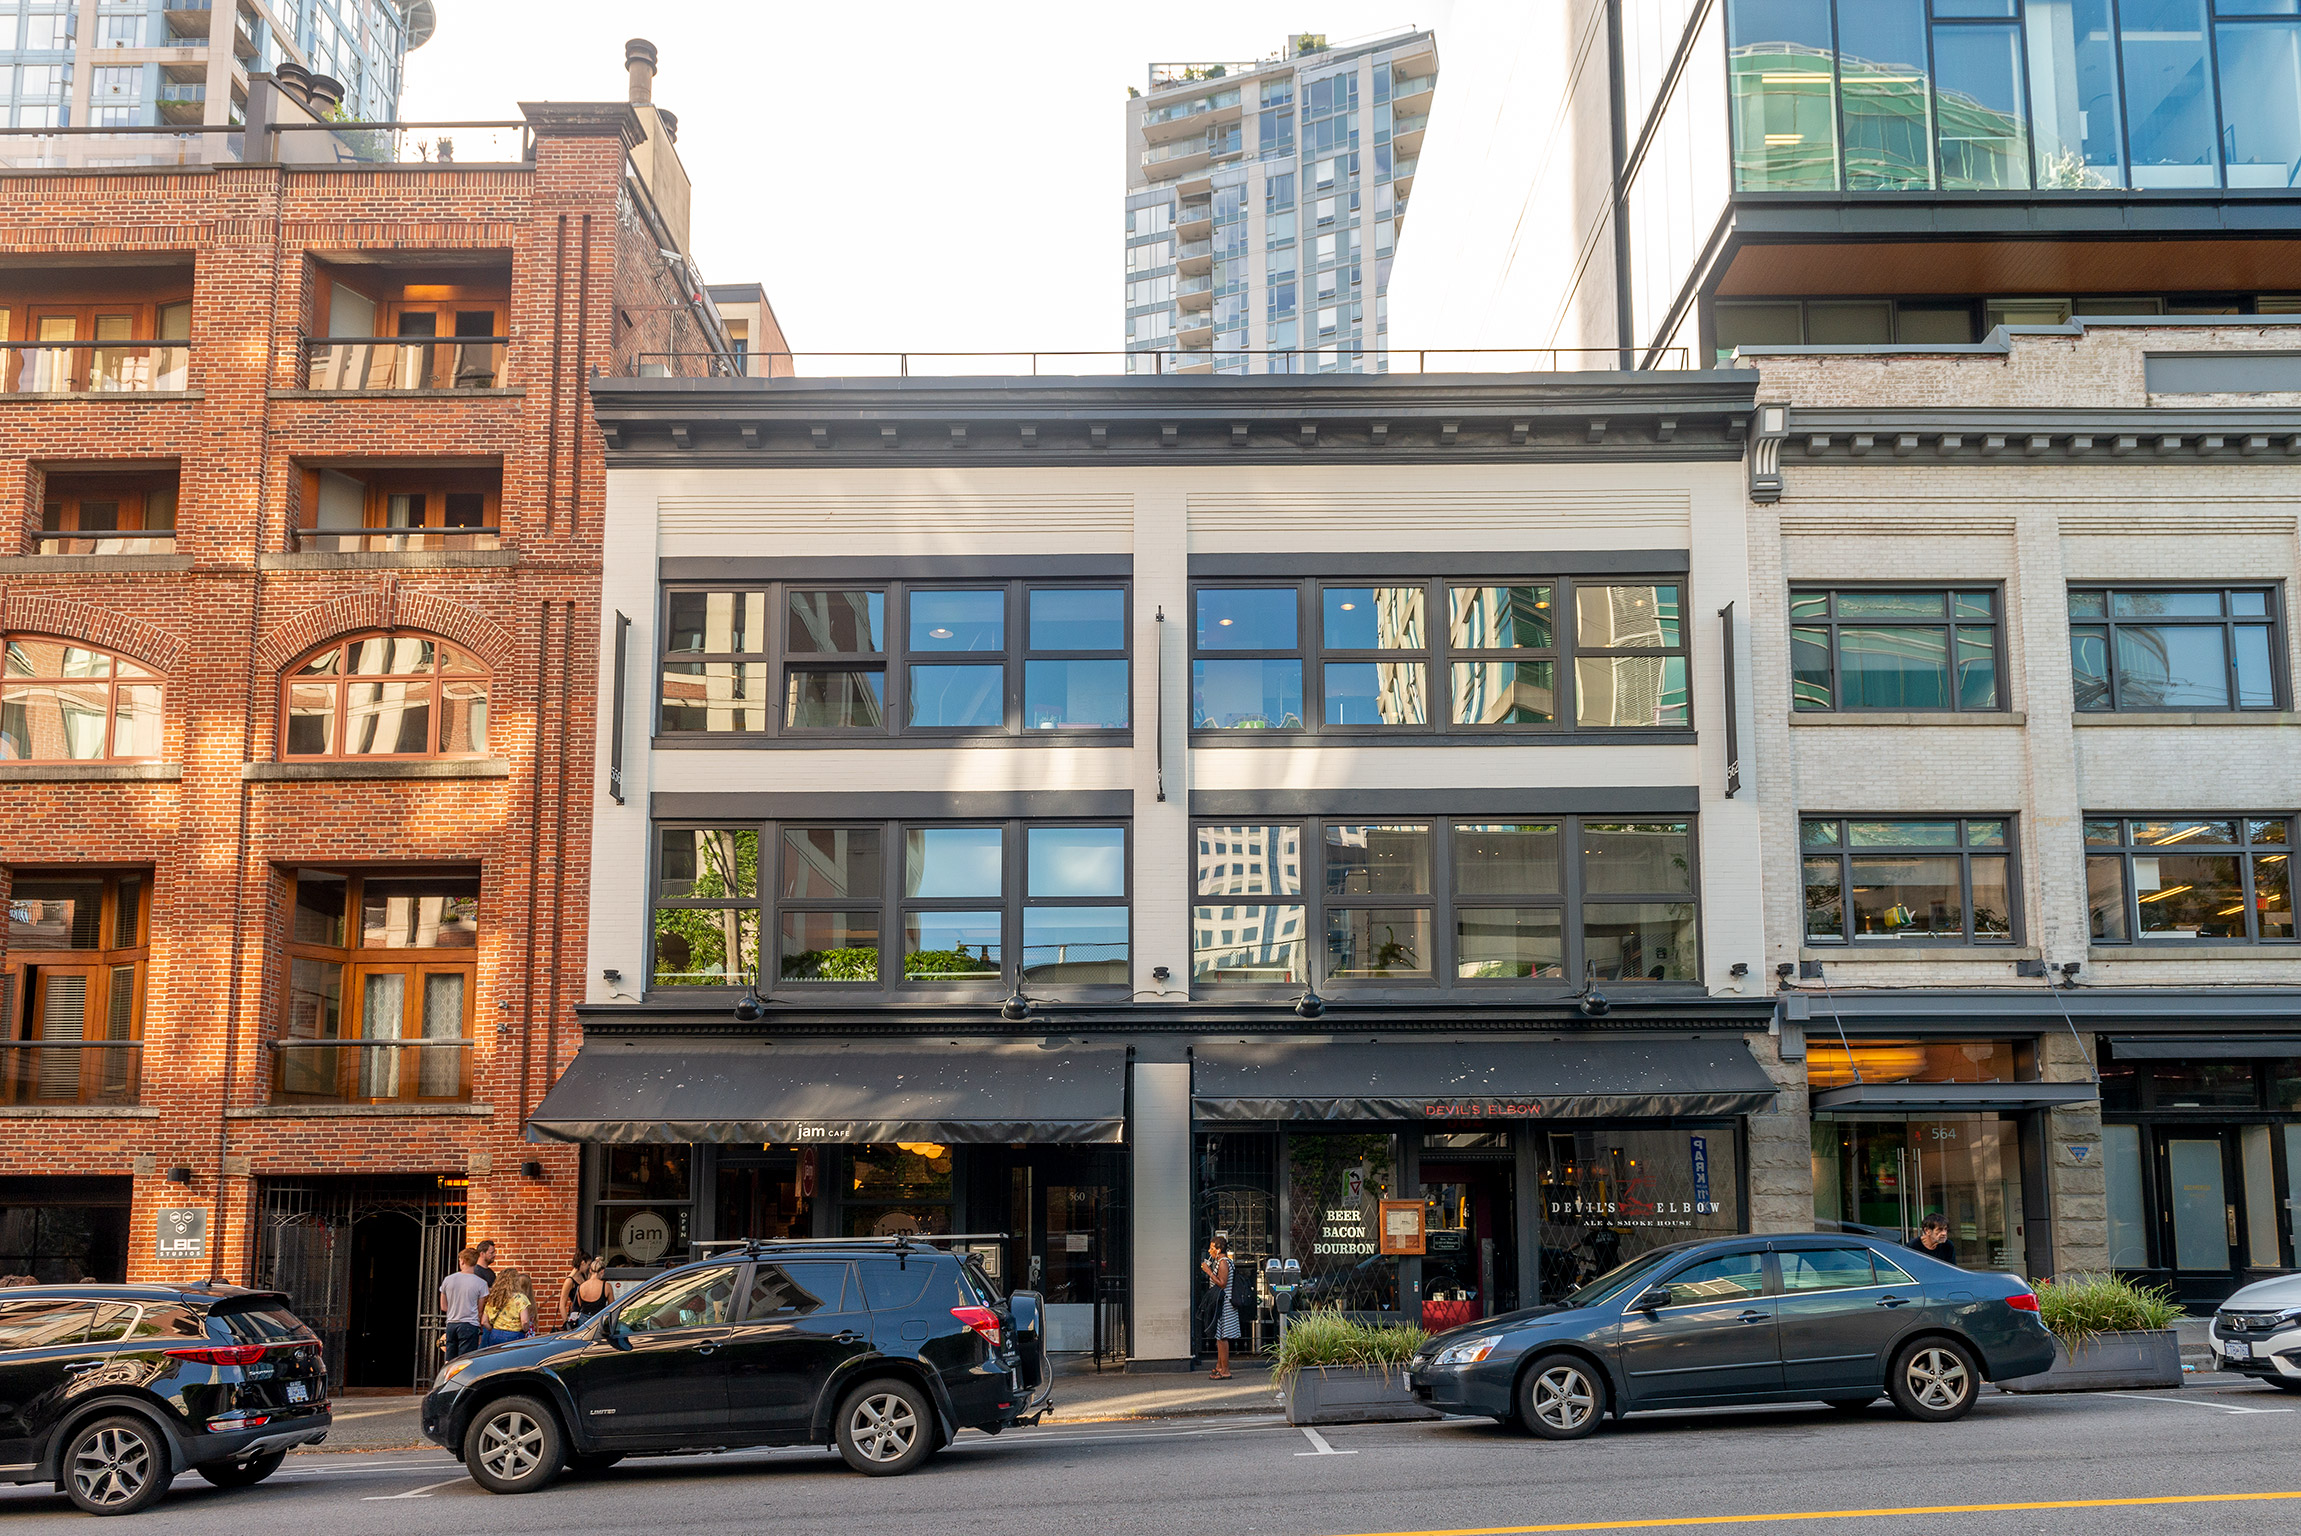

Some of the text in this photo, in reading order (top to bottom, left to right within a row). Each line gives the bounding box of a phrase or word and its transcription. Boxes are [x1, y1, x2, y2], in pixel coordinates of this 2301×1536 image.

[1426, 1105, 1541, 1115] DEVIL'S ELBOW
[797, 1124, 825, 1140] jam
[1931, 1127, 1957, 1140] 564
[1069, 1191, 1086, 1201] 560
[1551, 1202, 1720, 1213] DEVIL'S ELBOW
[1326, 1210, 1361, 1221] BEER
[680, 1212, 688, 1238] OPEN
[628, 1225, 662, 1245] jam
[1322, 1226, 1366, 1238] BACON
[160, 1239, 201, 1250] LBC
[1313, 1243, 1376, 1254] BOURBON
